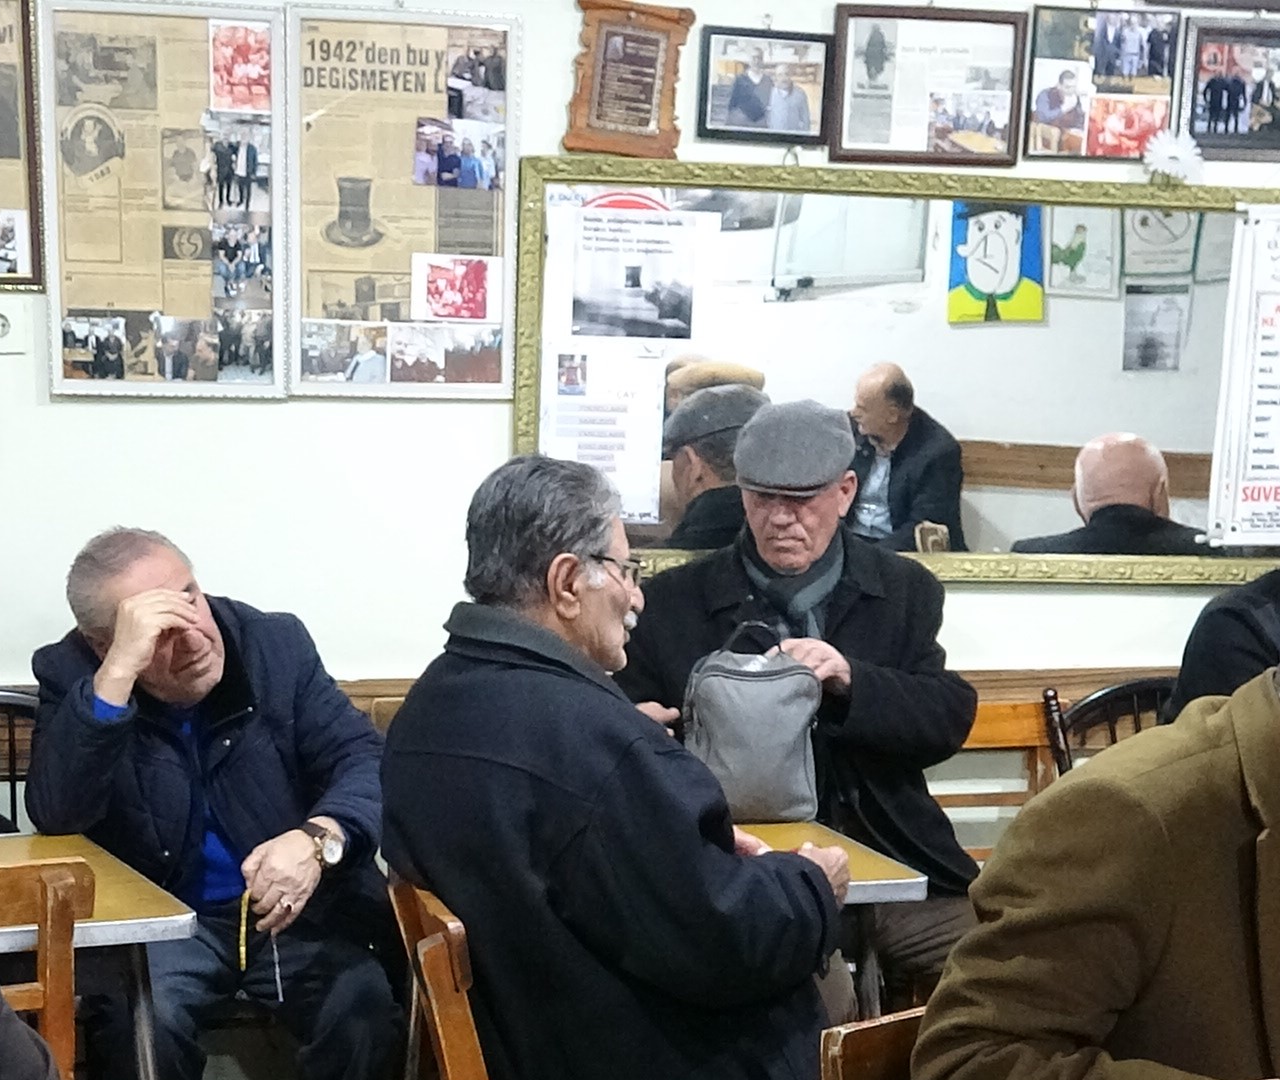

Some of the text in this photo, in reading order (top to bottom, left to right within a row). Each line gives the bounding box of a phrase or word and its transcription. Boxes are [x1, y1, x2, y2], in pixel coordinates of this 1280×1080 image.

[306, 38, 448, 70] 1942'den bu y
[433, 71, 445, 94] L
